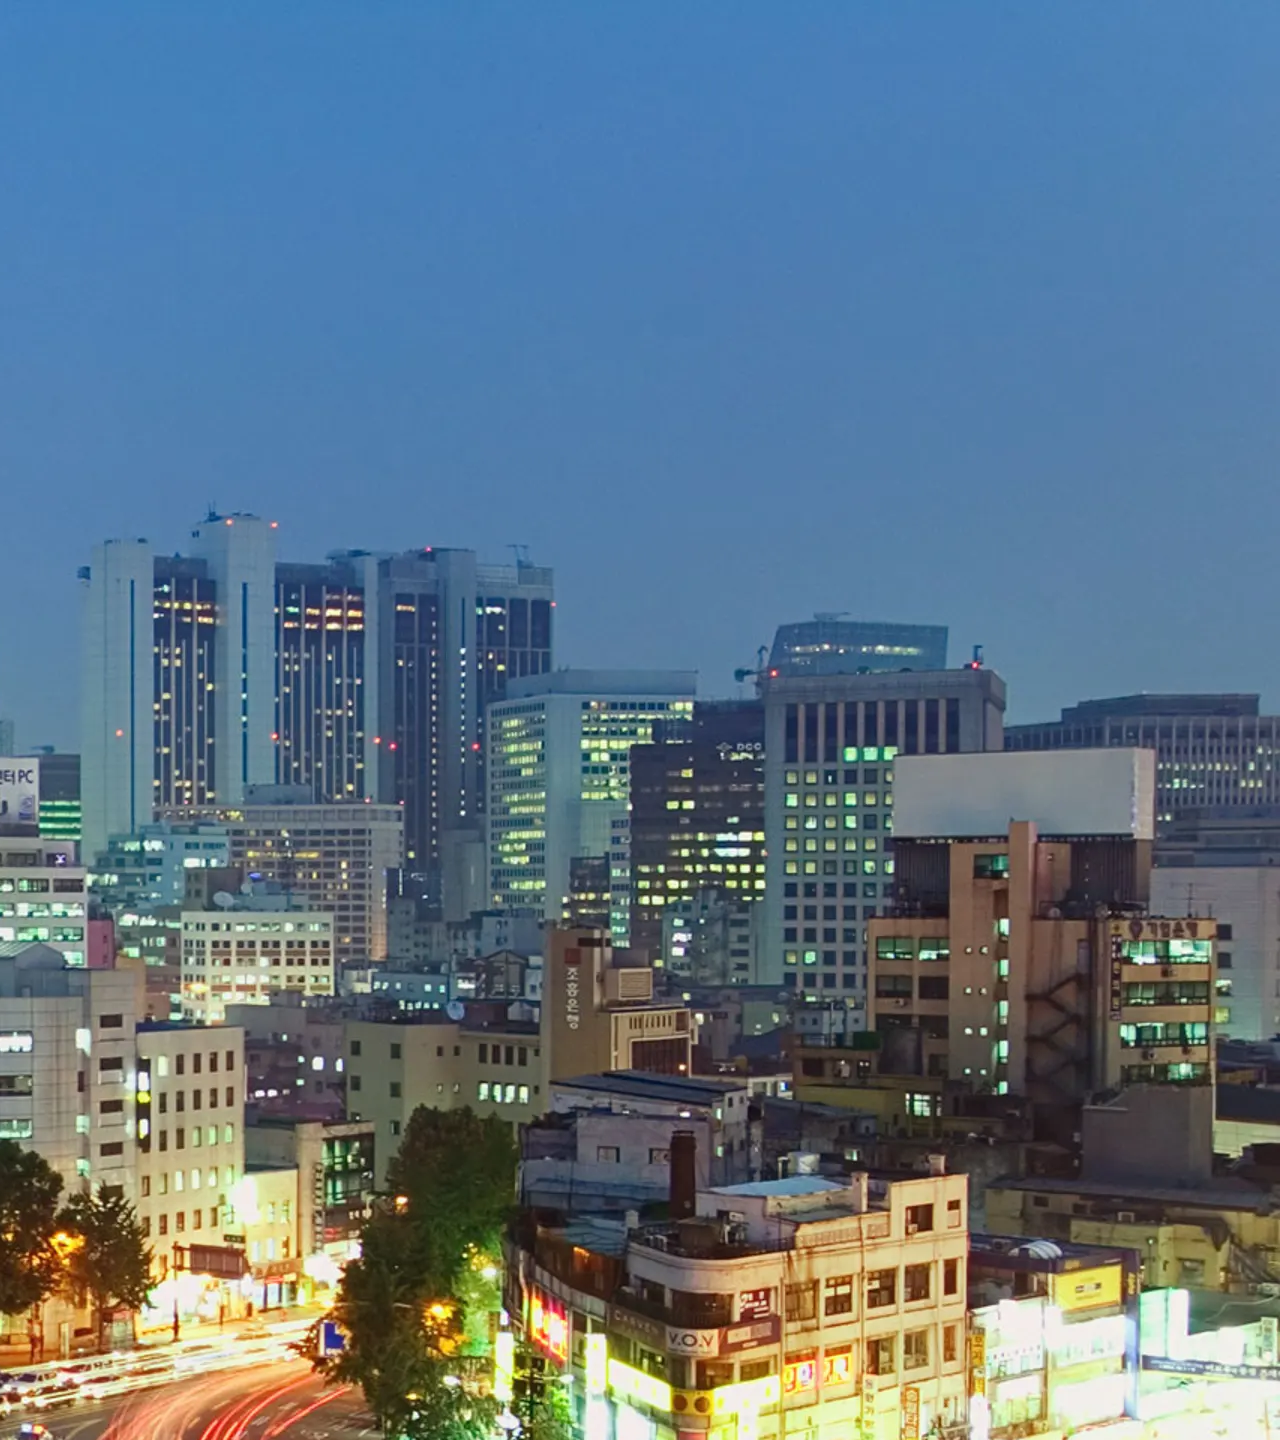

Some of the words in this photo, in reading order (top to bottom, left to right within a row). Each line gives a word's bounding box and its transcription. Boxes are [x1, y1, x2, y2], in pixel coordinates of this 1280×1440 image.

[18, 769, 34, 784] PC
[565, 966, 580, 1030] 조흥은행
[668, 1331, 714, 1348] V.O.V
